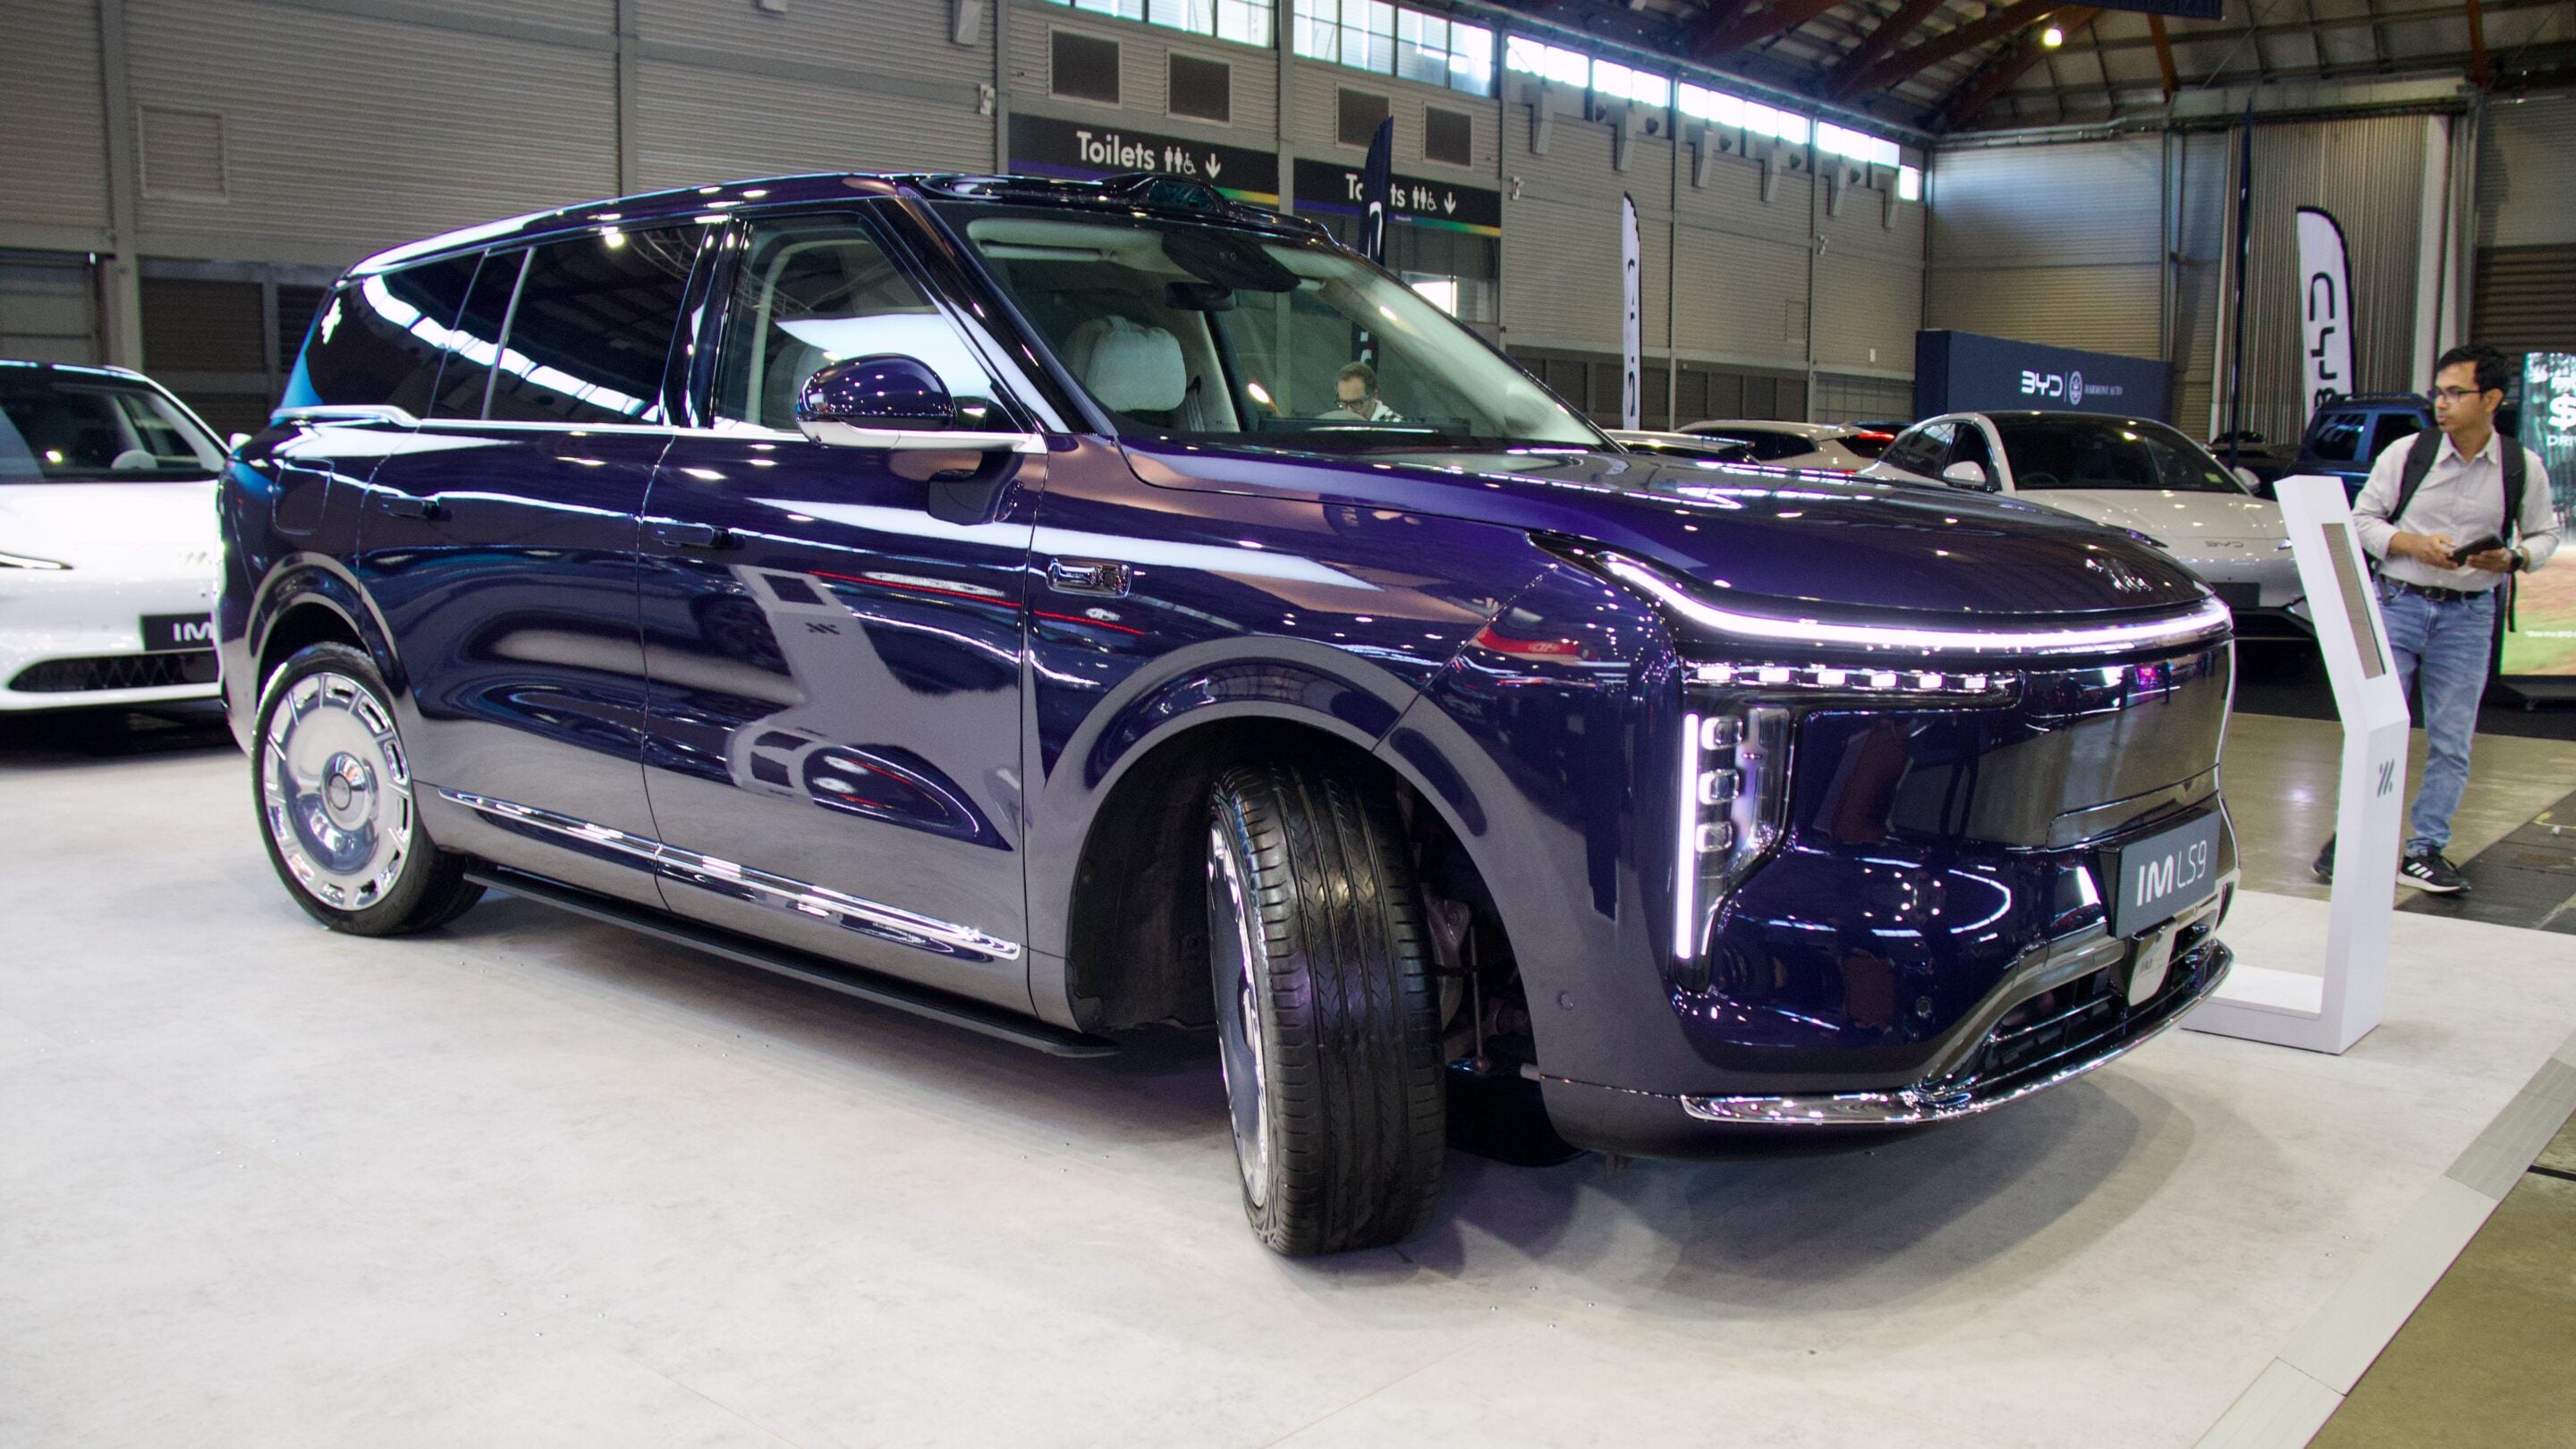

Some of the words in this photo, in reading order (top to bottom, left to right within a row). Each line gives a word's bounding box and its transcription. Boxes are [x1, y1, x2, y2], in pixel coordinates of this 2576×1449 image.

[1076, 130, 1156, 171] Toilets
[2021, 370, 2063, 396] BYD
[2137, 854, 2174, 907] IM
[2176, 840, 2207, 888] LS9
